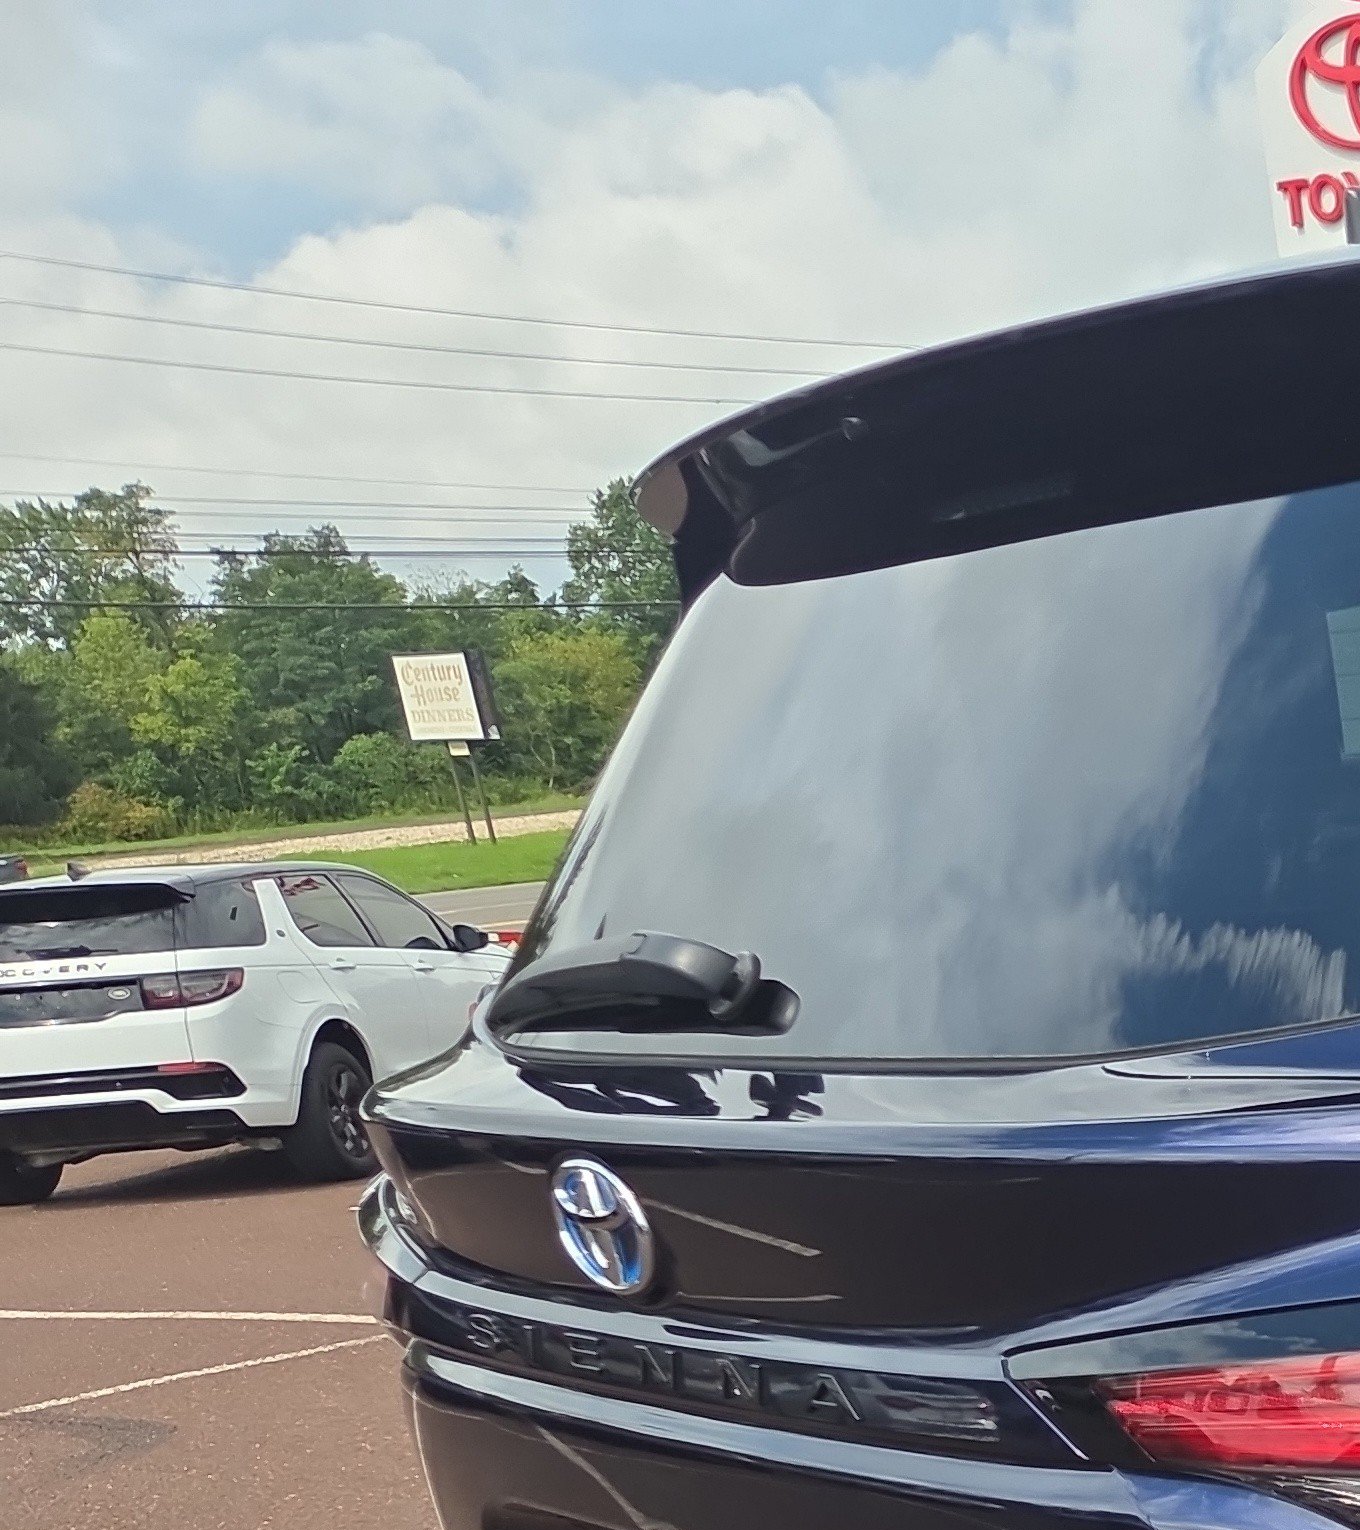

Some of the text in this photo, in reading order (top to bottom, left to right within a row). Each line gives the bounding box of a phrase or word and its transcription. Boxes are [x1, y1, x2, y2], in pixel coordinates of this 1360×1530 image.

[401, 660, 463, 686] Century
[411, 685, 461, 707] House
[411, 707, 475, 723] DINNERS
[466, 1313, 861, 1421] SIENNA
